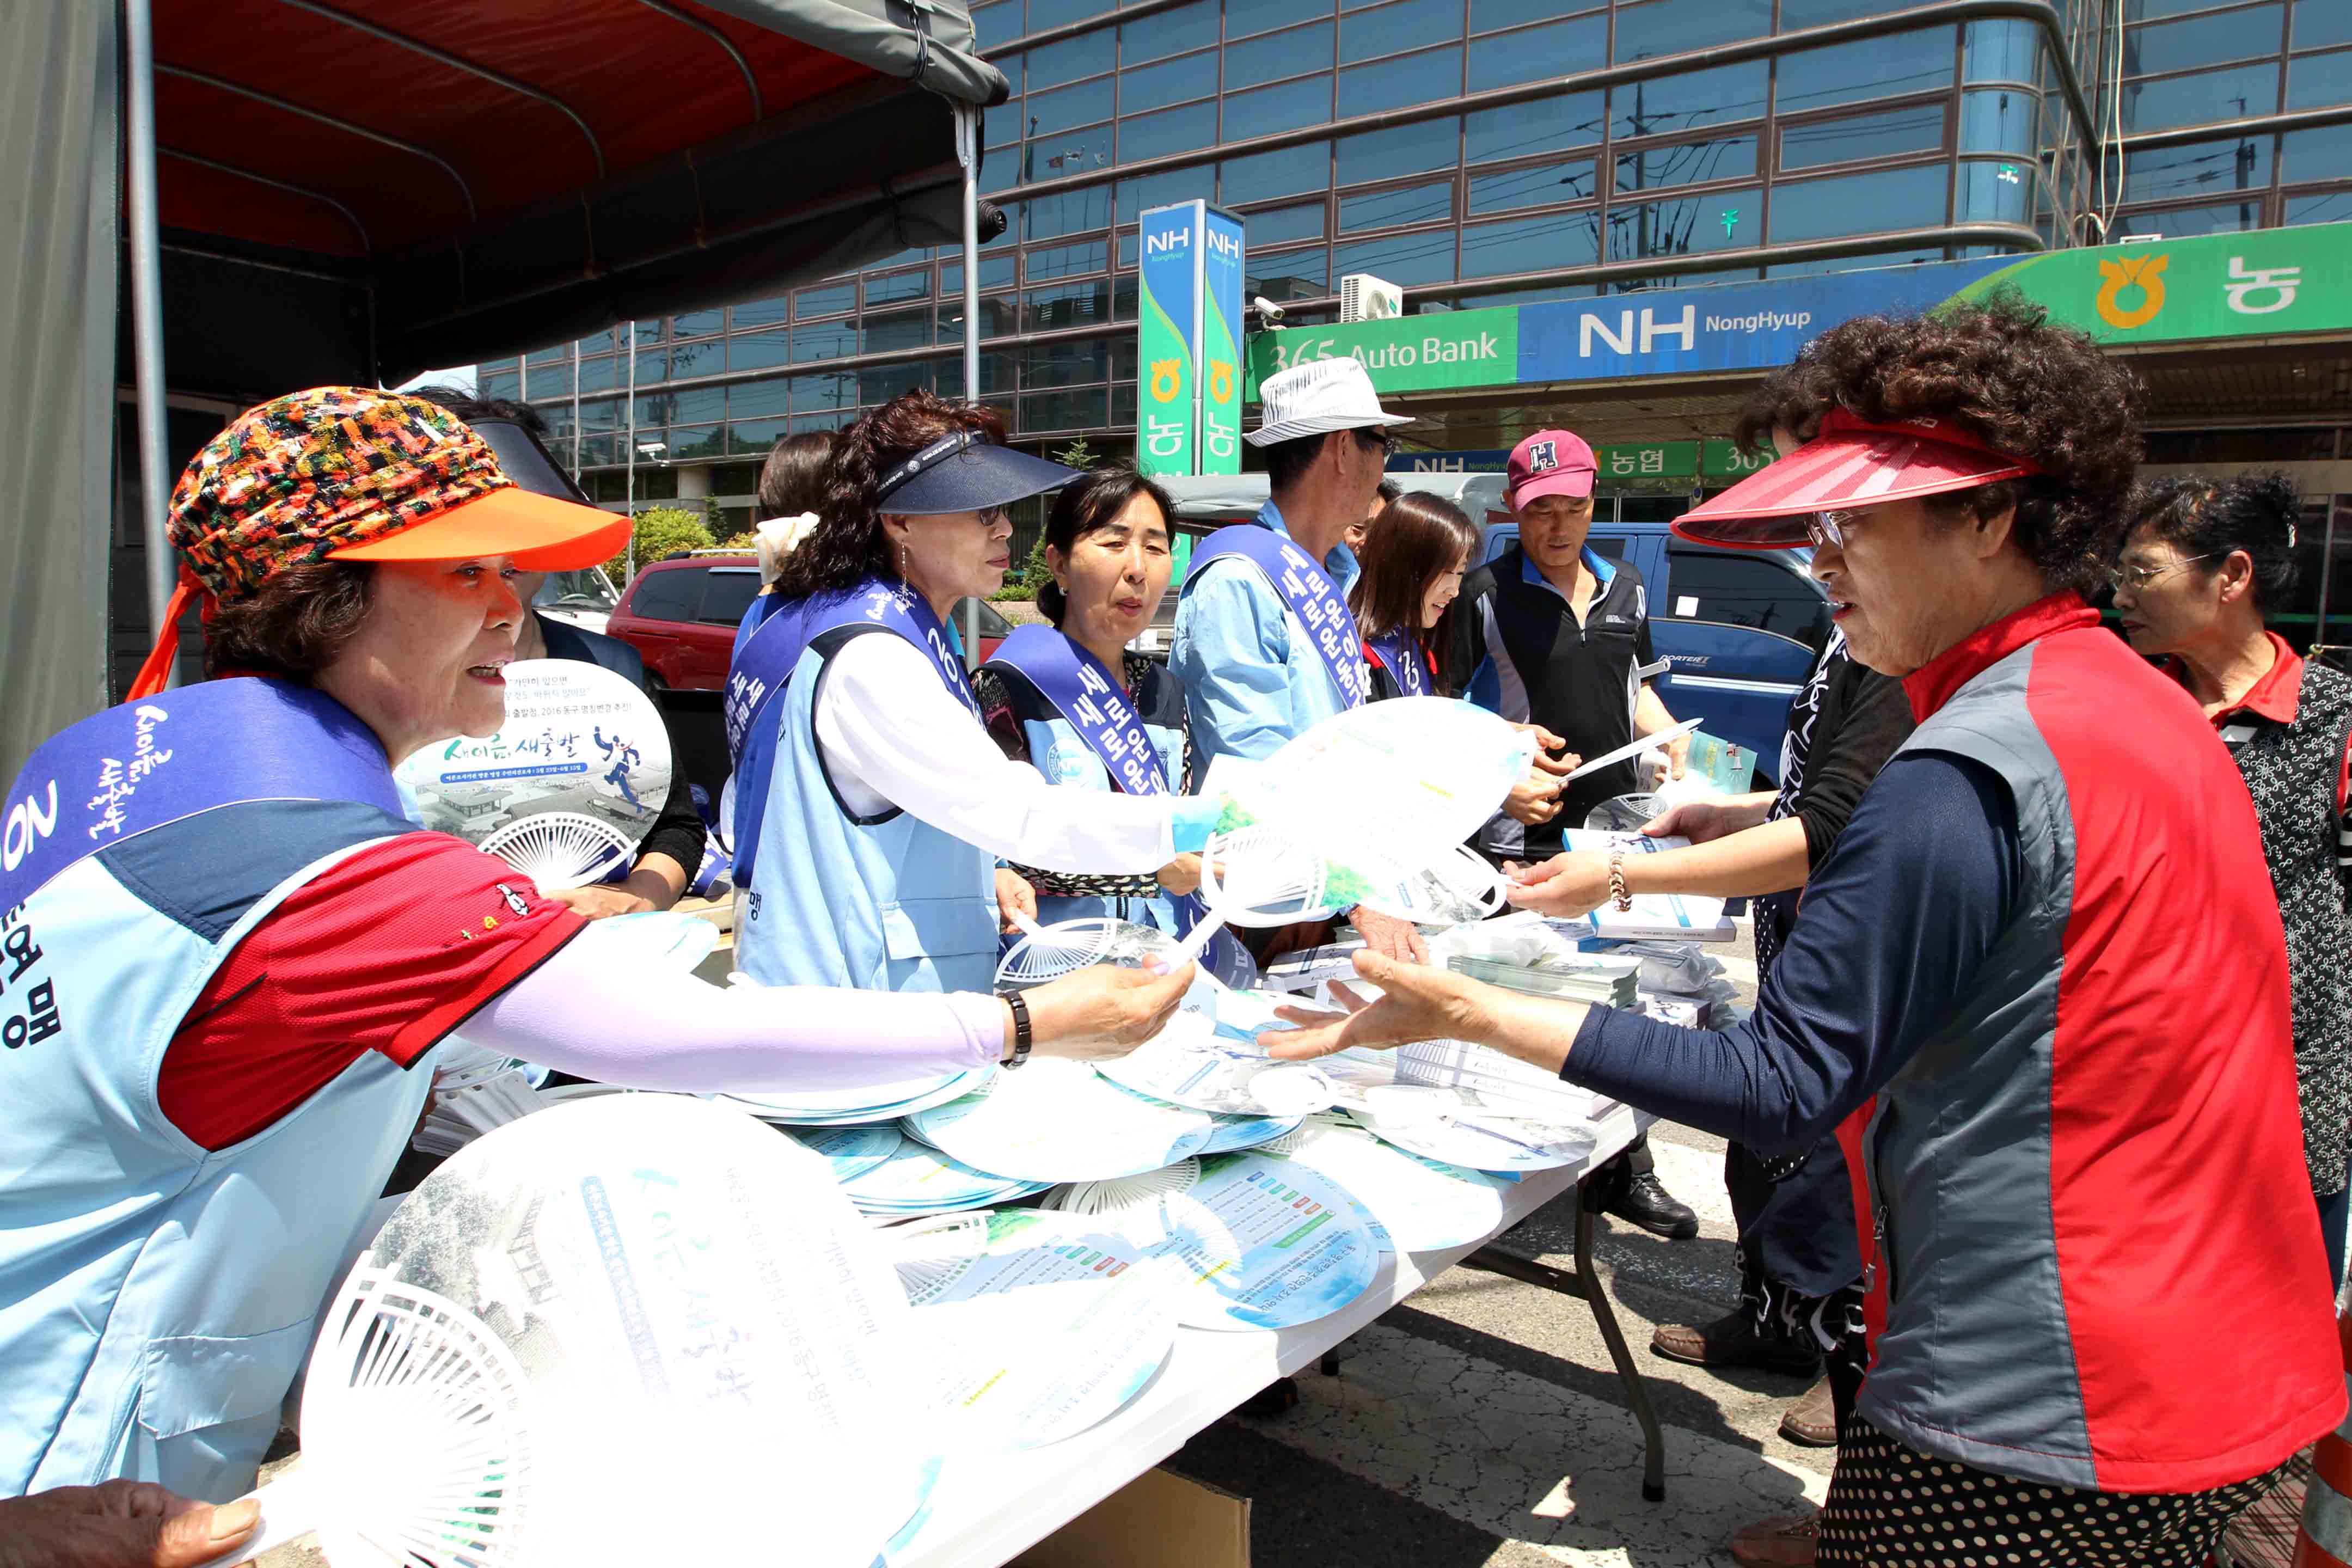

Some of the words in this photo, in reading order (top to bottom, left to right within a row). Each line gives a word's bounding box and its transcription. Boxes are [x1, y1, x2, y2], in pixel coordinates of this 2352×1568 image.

[1148, 226, 1189, 254] NH
[1208, 229, 1239, 259] NH
[2224, 256, 2301, 314] 농
[1579, 304, 1695, 357] NH
[1706, 310, 1811, 333] NongHyup
[1350, 343, 1416, 370] Auto
[1423, 331, 1498, 364] Bank
[1529, 440, 1558, 473] H
[1611, 449, 1663, 474] 농협
[541, 706, 562, 716] 2016
[1077, 663, 1150, 761] 새로운
[1073, 693, 1149, 795] 새로운
